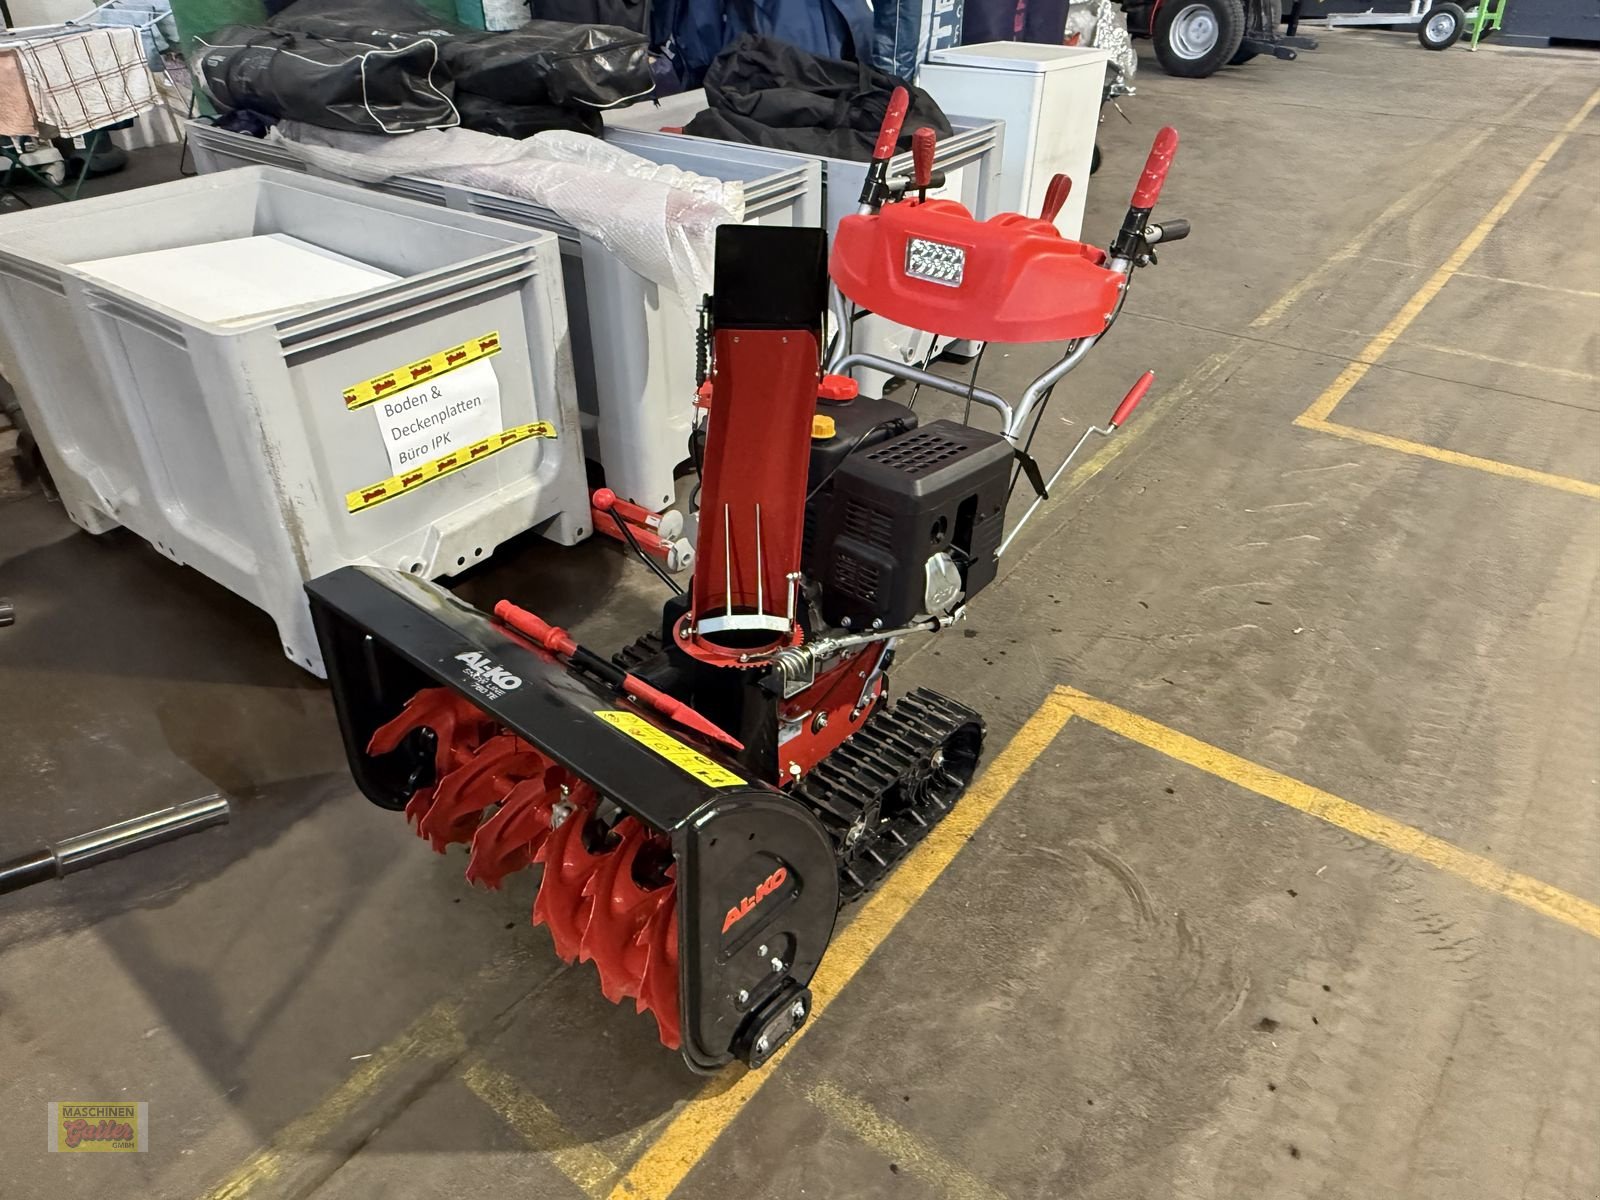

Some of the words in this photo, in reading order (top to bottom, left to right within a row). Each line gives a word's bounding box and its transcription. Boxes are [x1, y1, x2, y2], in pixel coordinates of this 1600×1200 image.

[384, 391, 429, 418] Boden
[431, 385, 443, 399] &
[391, 396, 482, 441] Deckenplatten
[399, 444, 429, 464] Büro
[432, 432, 453, 451] IPK
[454, 652, 522, 690] AL-KO
[486, 692, 500, 701] TE
[721, 866, 787, 934] AL-KO
